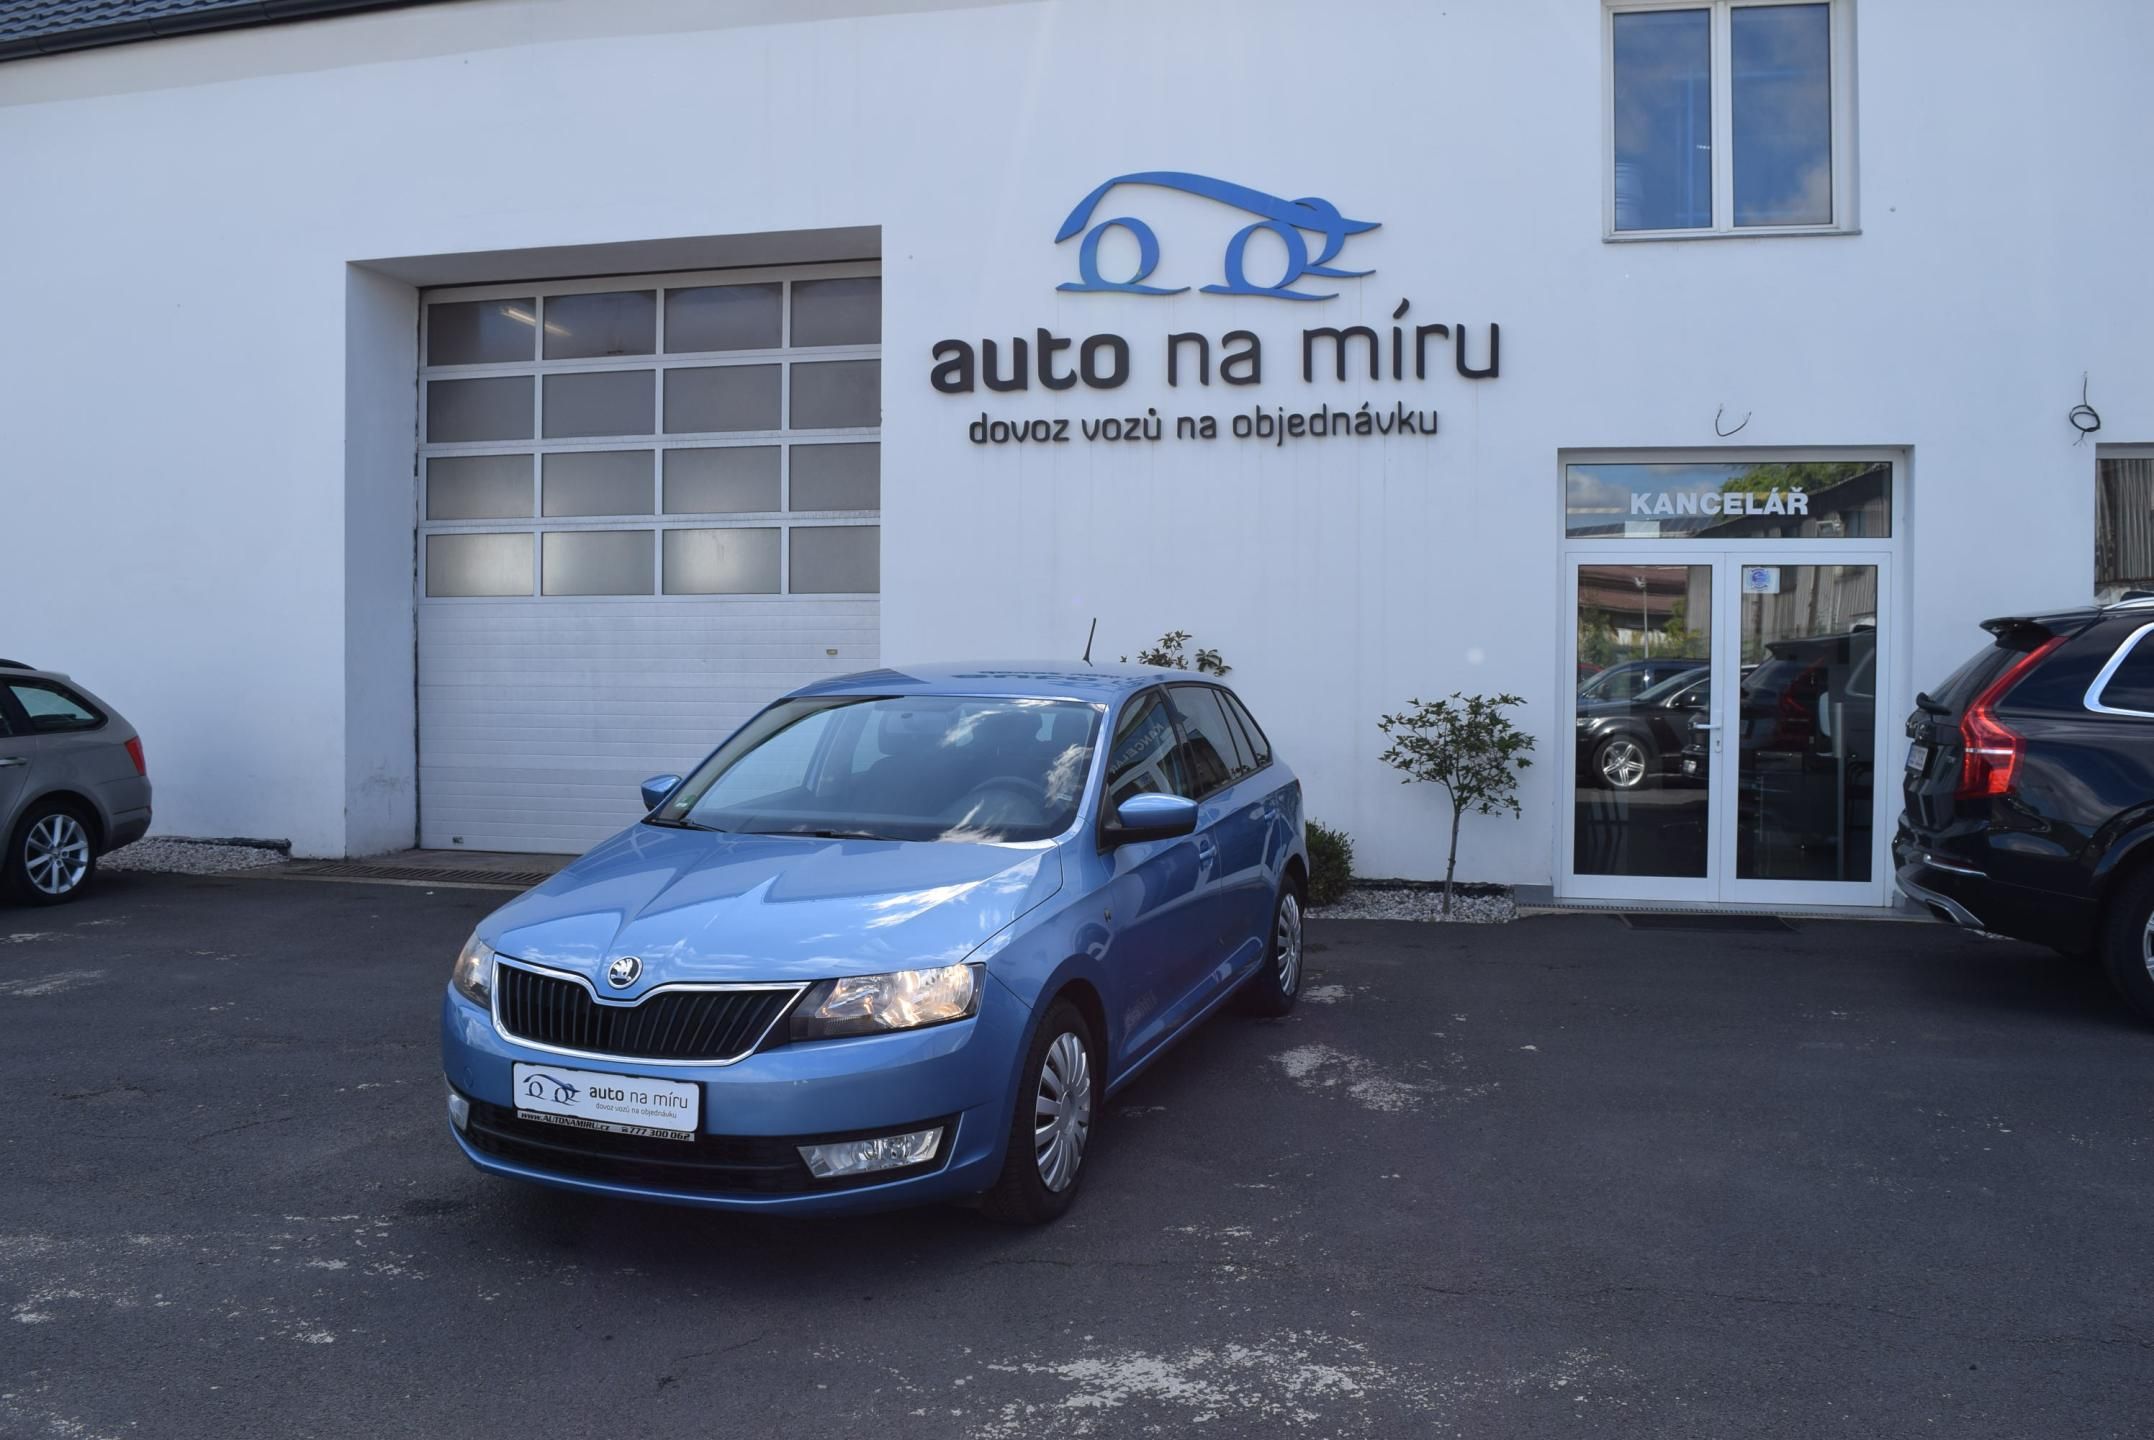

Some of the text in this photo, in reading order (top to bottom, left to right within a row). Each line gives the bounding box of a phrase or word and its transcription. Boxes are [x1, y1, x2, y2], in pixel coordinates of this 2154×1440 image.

[930, 298, 1500, 394] auto na míru
[968, 401, 1438, 447] dovoz vozů na objednávku
[1630, 487, 1809, 516] KANCELÁŘ
[589, 1086, 688, 1109] auto na míru
[649, 1129, 668, 1138] 300
